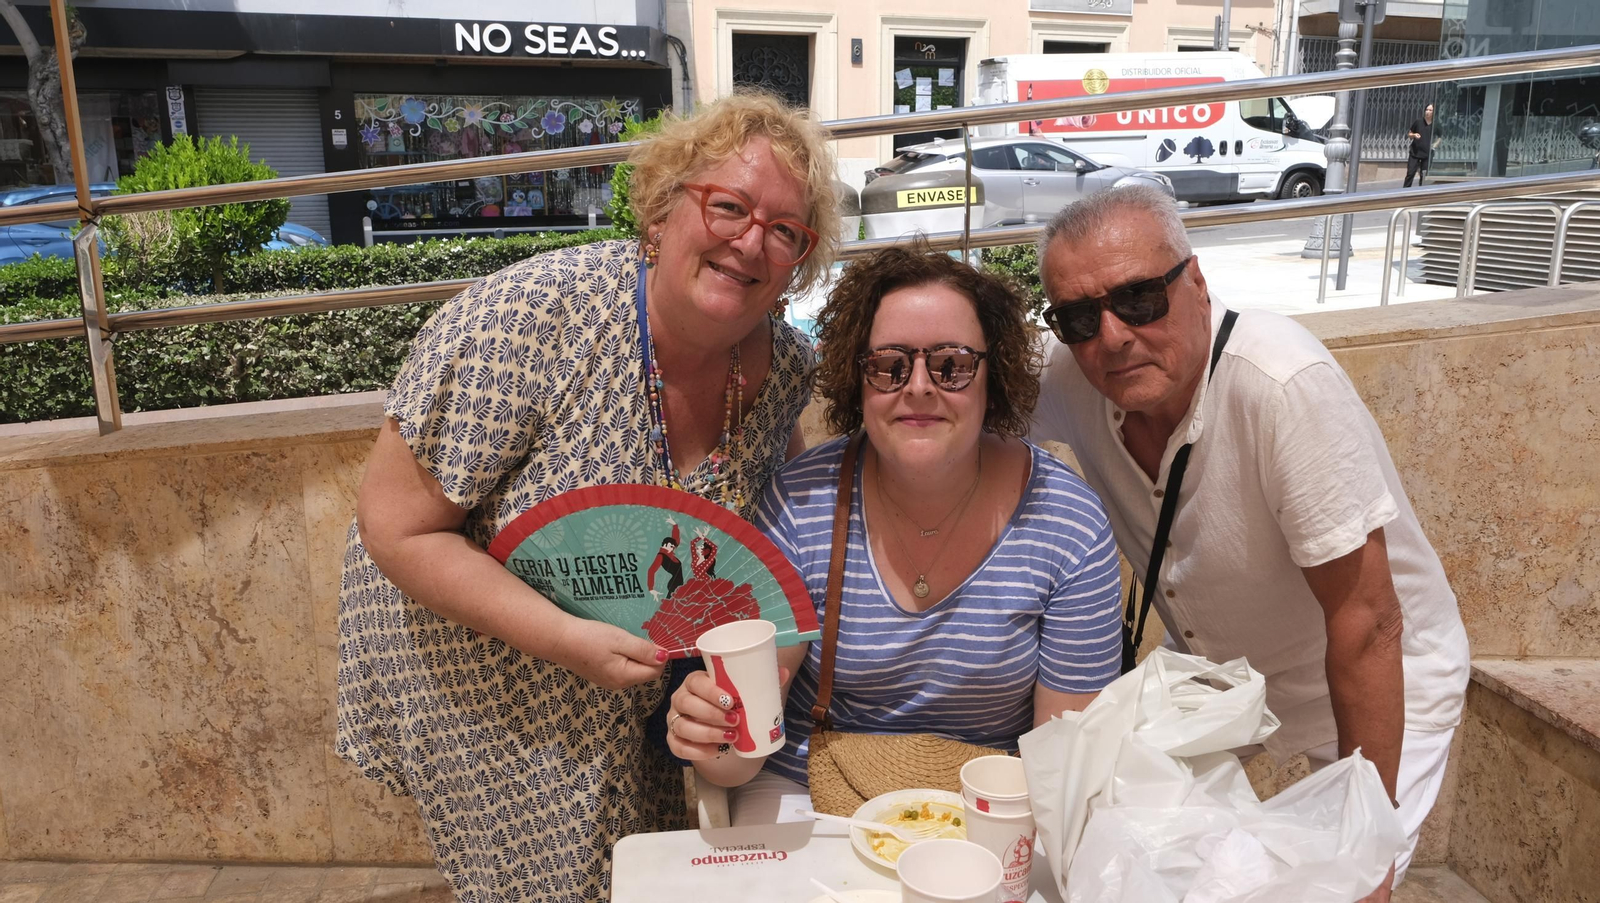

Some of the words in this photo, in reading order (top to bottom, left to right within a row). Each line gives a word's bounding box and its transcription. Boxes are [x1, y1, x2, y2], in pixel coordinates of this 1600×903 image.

[455, 22, 512, 53] NO
[524, 24, 646, 57] SEAS...
[853, 44, 861, 56] 6
[1121, 67, 1172, 77] DISTRIBUIDOR
[1174, 66, 1202, 76] OFICIAL
[334, 109, 342, 120] 5
[907, 189, 966, 204] ENVASE
[556, 557, 570, 577] Y
[571, 573, 644, 597] ALMERÍA
[710, 843, 766, 853] ESPECIAL
[690, 850, 788, 866] Cruzcampo
